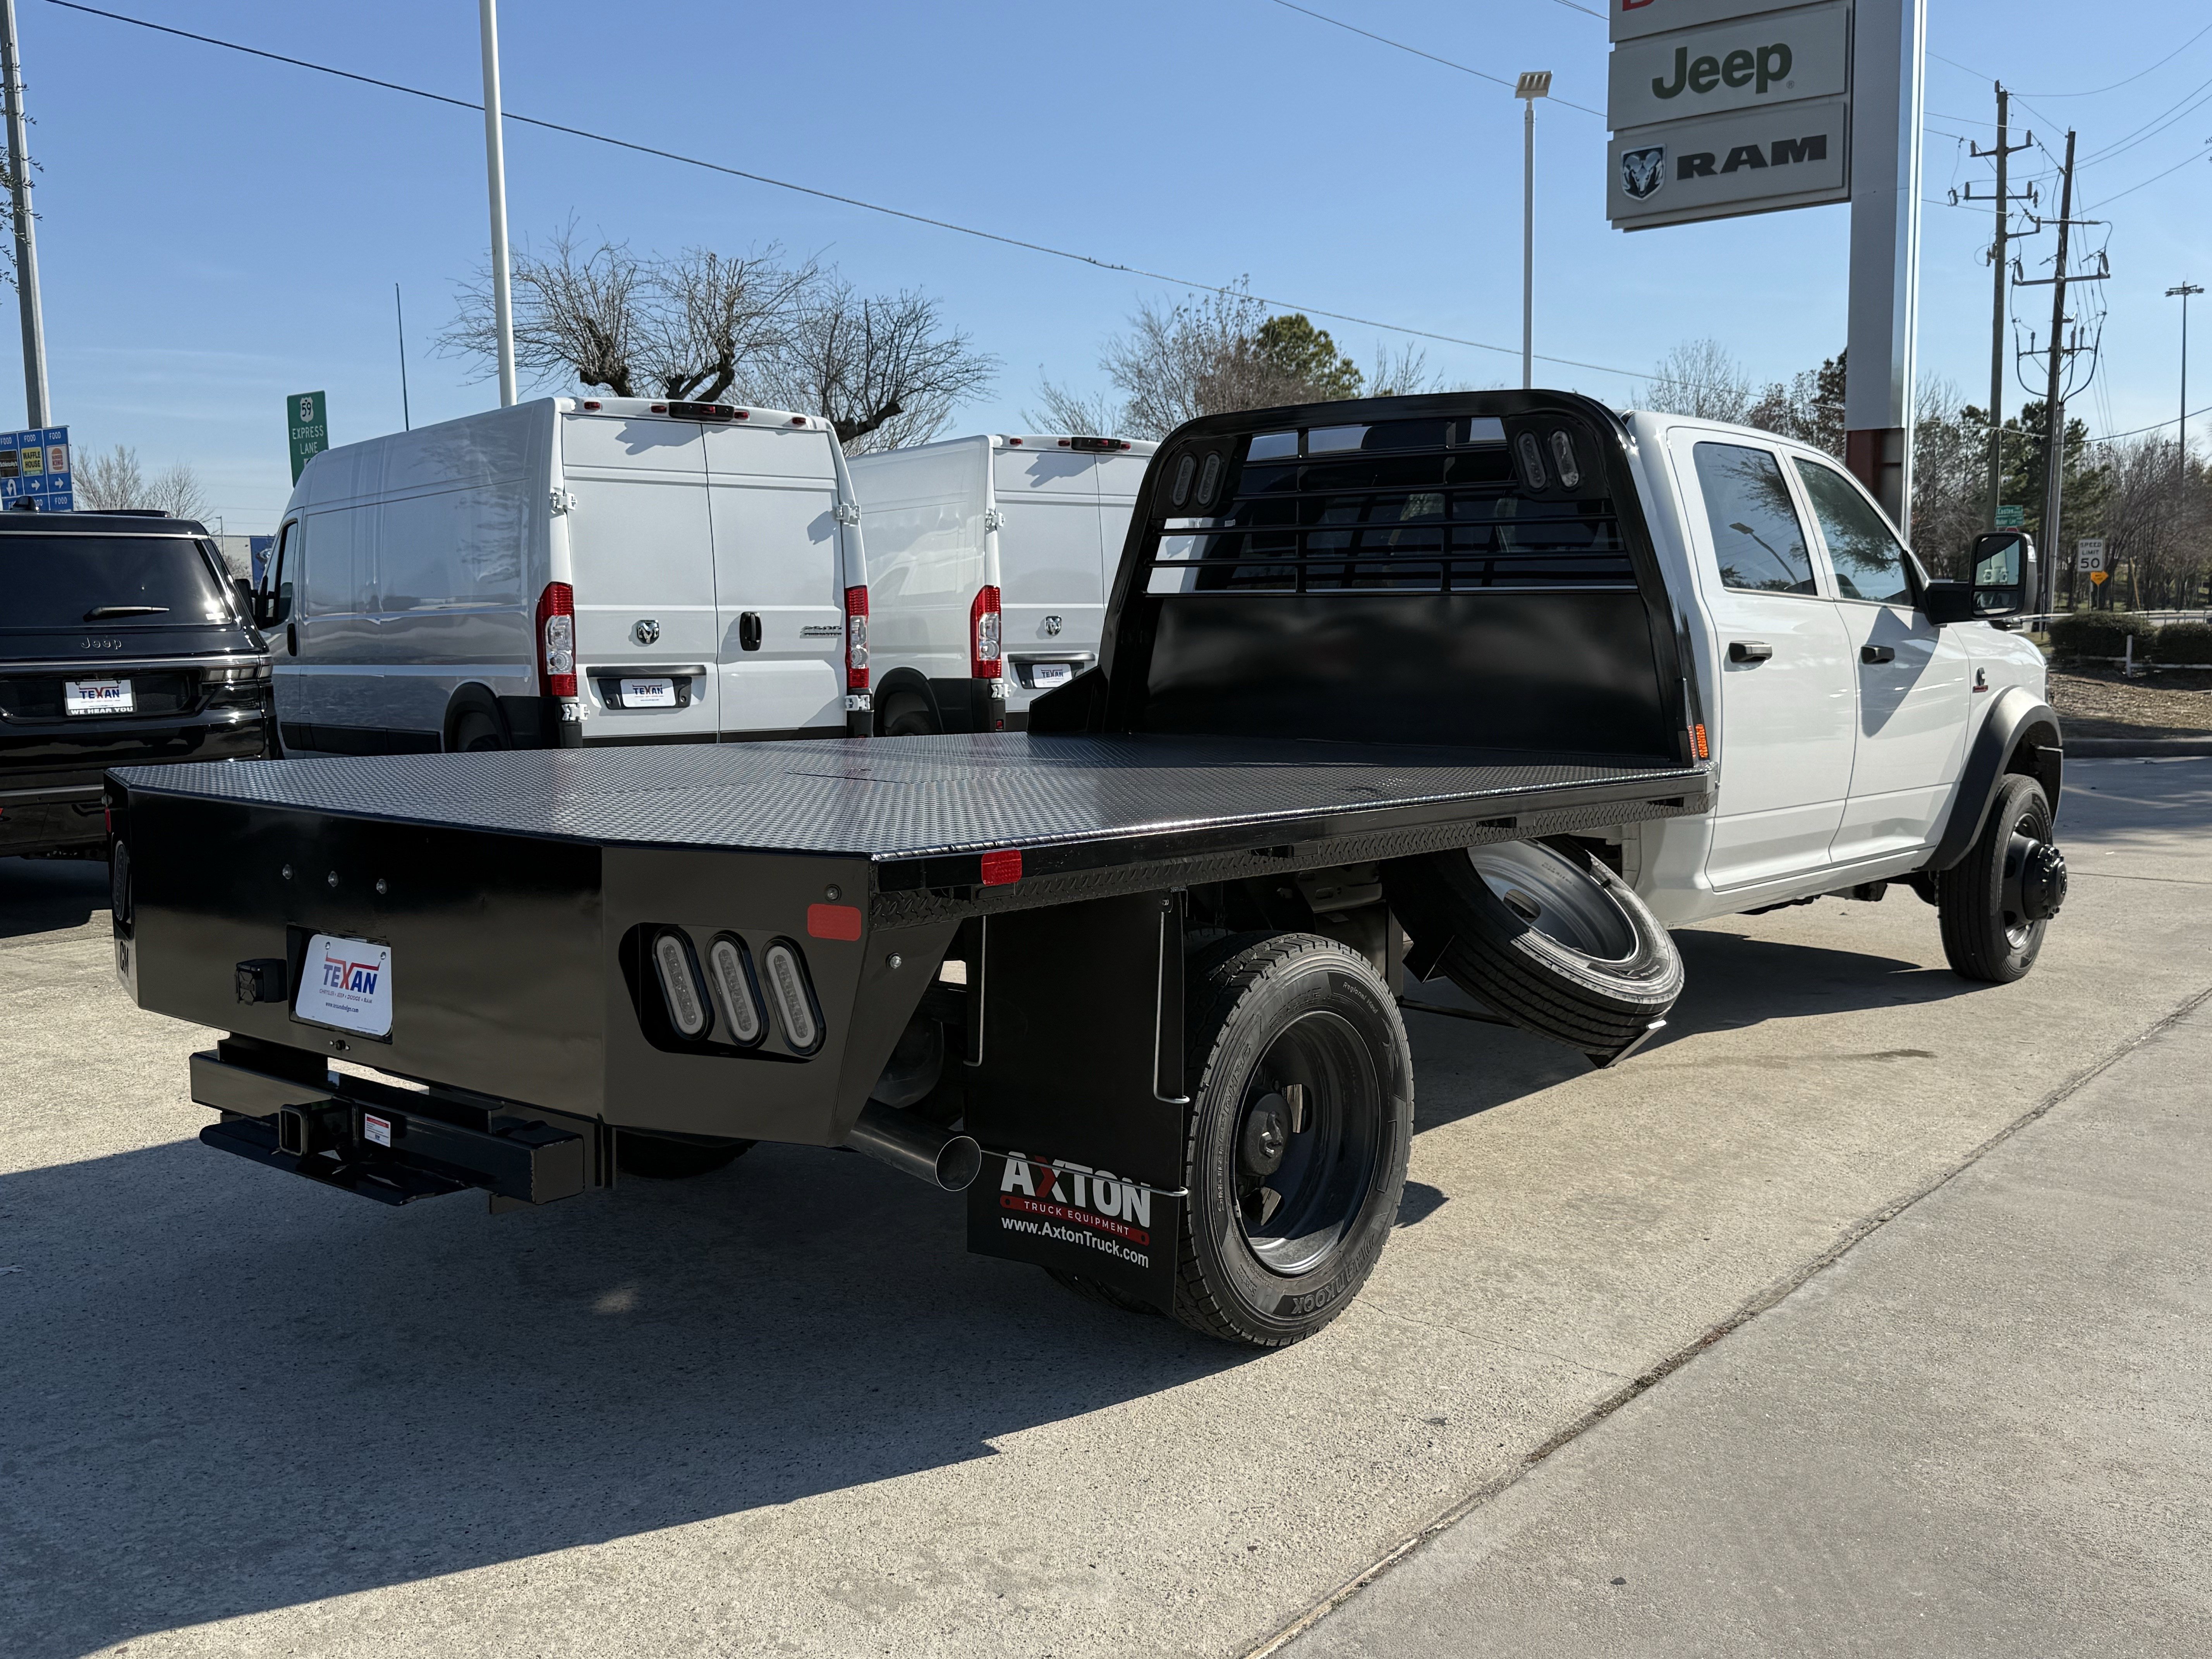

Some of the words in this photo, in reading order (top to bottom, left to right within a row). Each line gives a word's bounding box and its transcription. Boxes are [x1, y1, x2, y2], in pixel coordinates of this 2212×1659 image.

[1652, 43, 1792, 99] Jeep
[1676, 134, 1827, 180] RAM
[302, 402, 311, 417] 59
[24, 434, 36, 442] FOOD
[49, 431, 61, 440] FOOD
[292, 425, 324, 440] EXPRESS
[300, 442, 318, 455] LANE
[55, 496, 67, 505] FOOD
[2081, 558, 2100, 568] 50
[80, 637, 122, 650] Jeep
[79, 687, 120, 699] TEXAN
[633, 685, 663, 695] TEXAN
[323, 958, 379, 995] TEXAN
[1343, 982, 1367, 1000] Regional
[1000, 1151, 1151, 1228] AXTON
[1024, 1201, 1062, 1216] TRUCK
[1068, 1210, 1129, 1235] EQUIPMENT
[1001, 1217, 1149, 1268] www.AxtonTruck.com
